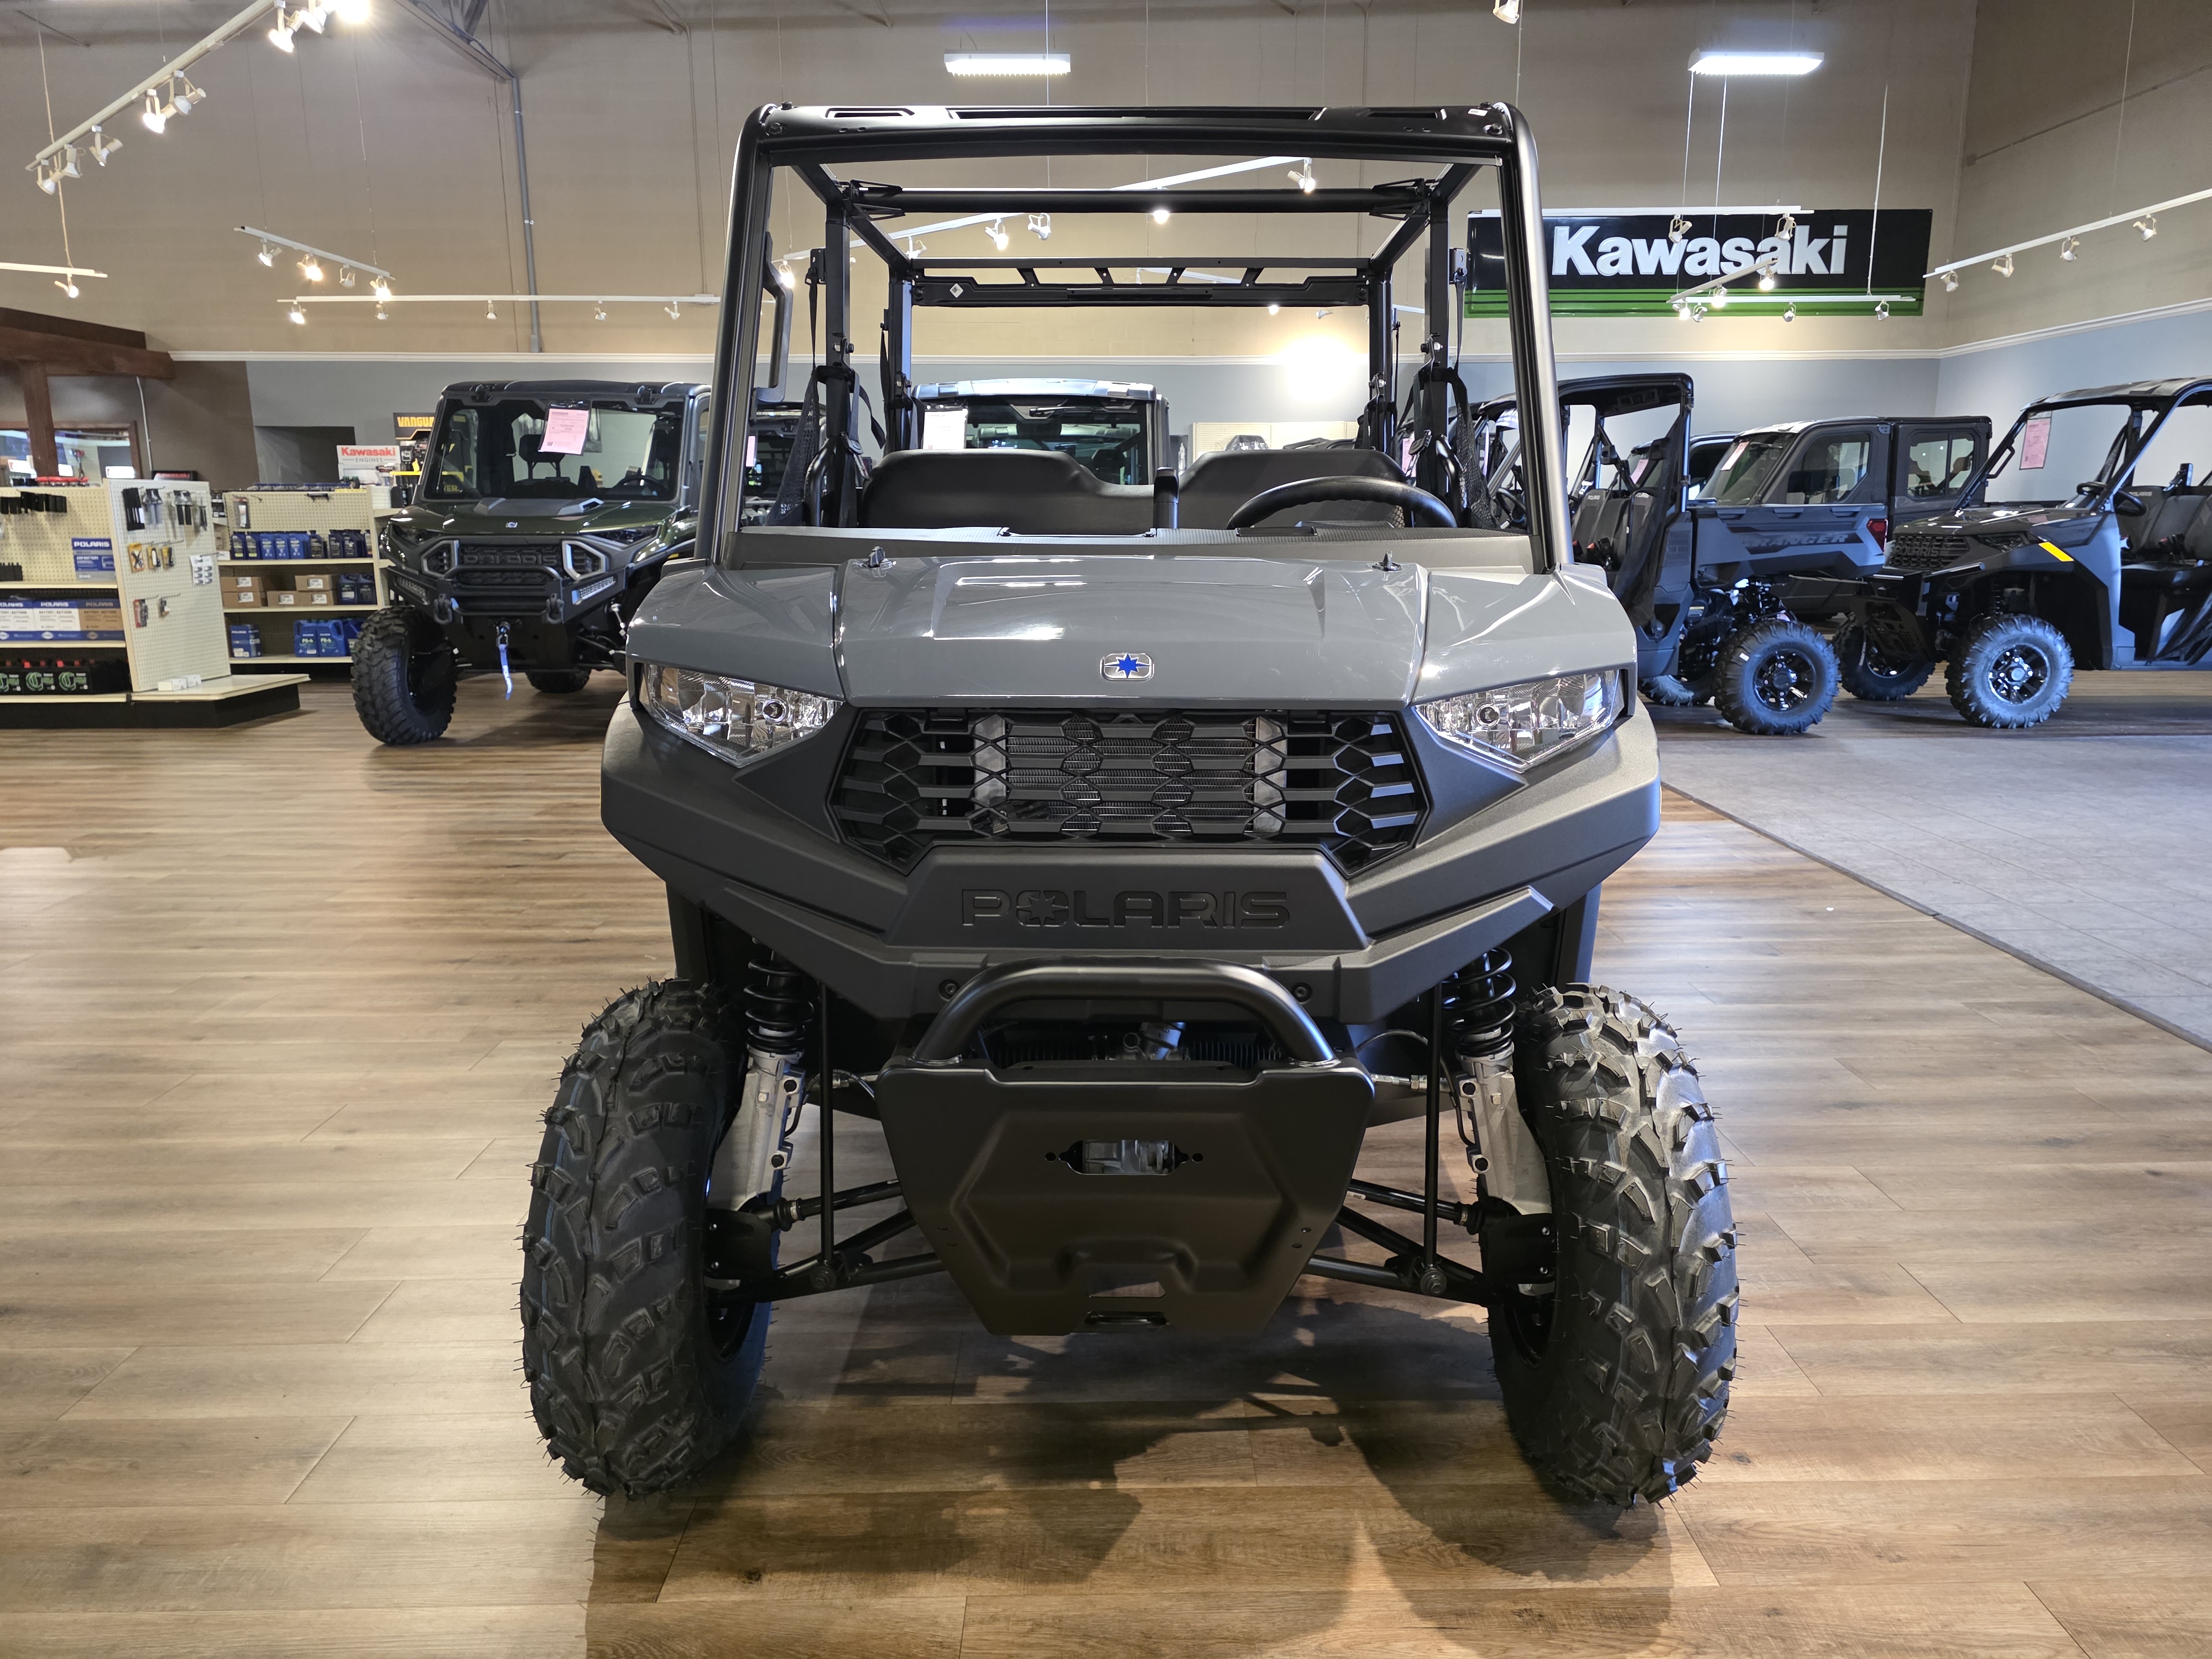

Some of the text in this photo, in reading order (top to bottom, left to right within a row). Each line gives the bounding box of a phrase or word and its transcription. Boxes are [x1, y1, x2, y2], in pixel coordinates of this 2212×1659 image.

[1552, 226, 1848, 276] Kawasaki
[341, 447, 396, 456] Kawasaki
[1754, 534, 1849, 547] RANGER
[962, 889, 1290, 929] POLARIS
